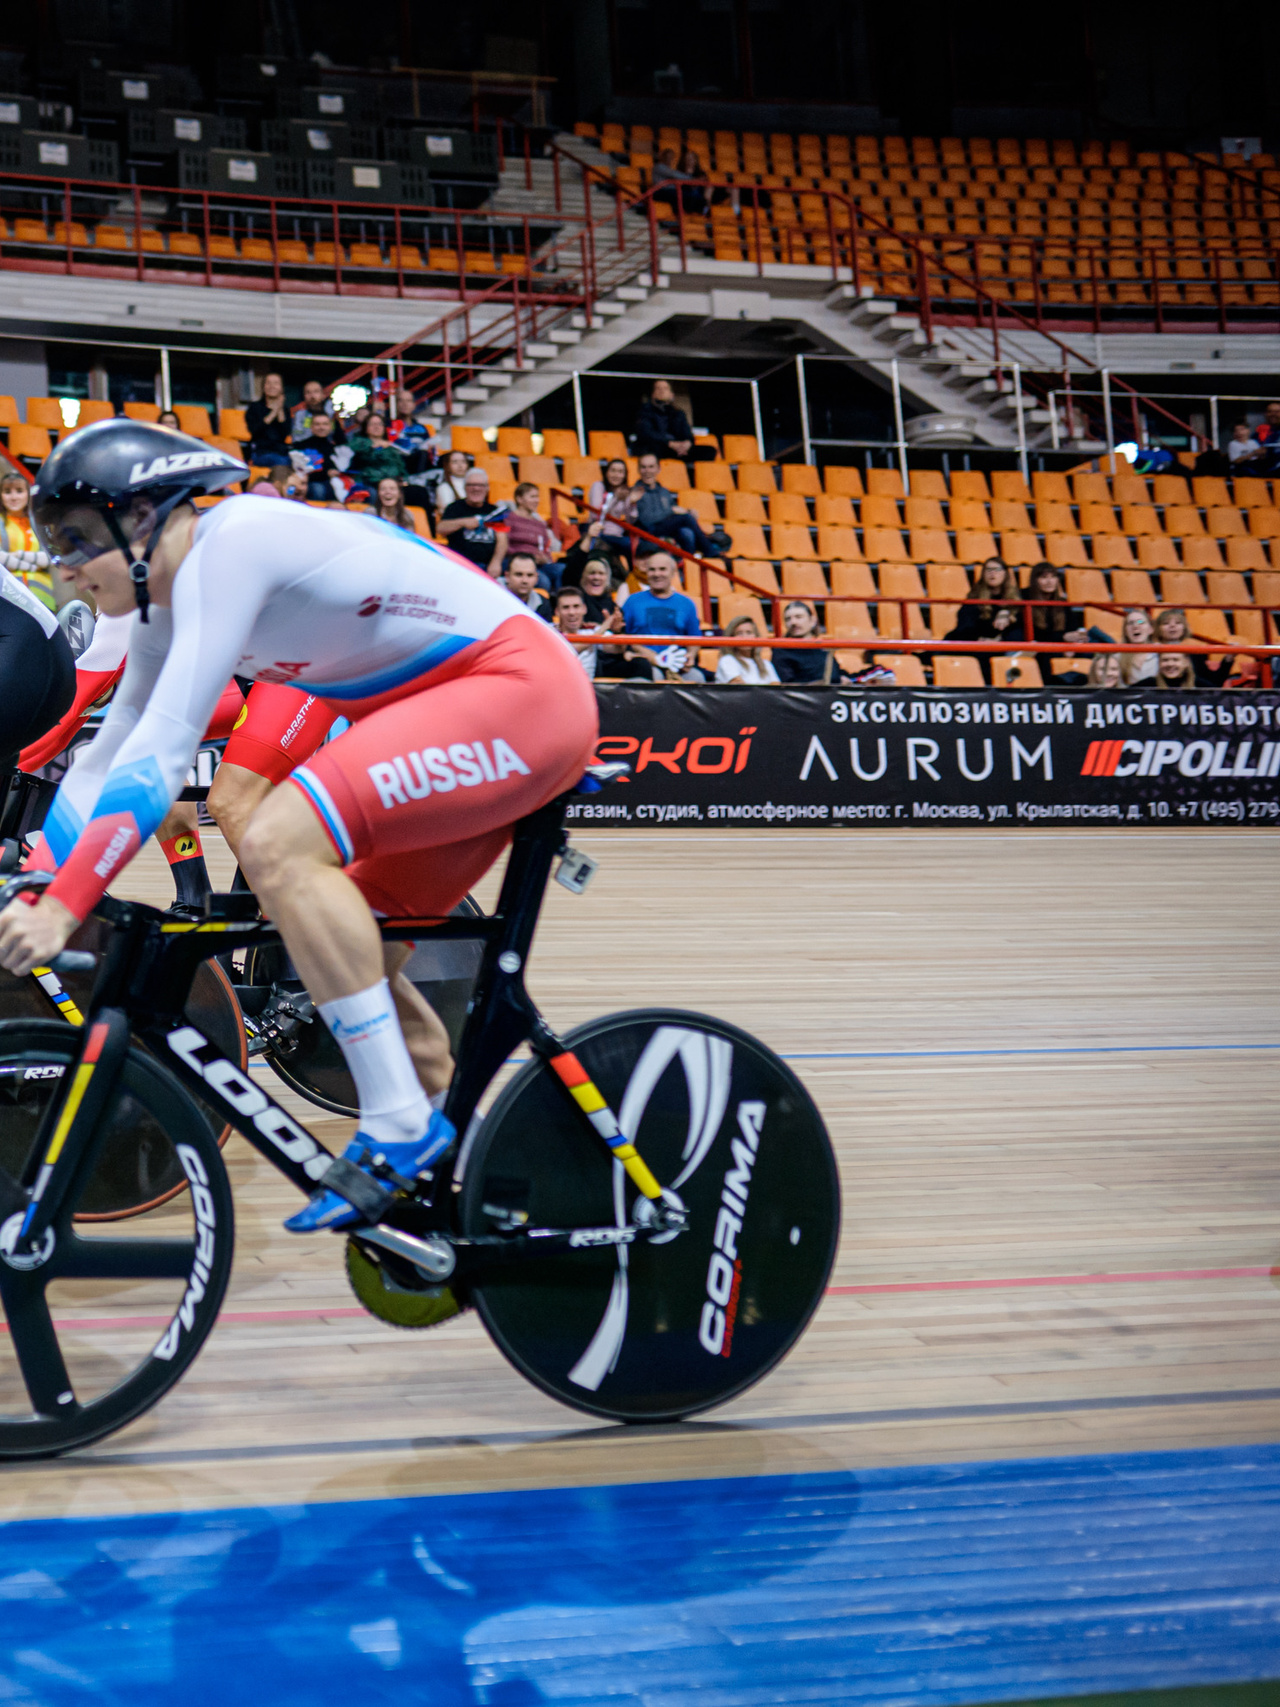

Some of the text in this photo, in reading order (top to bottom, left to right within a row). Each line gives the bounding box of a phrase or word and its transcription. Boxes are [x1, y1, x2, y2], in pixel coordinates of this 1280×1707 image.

[129, 451, 224, 485] LAZER
[383, 605, 457, 627] HELICOPTERS
[389, 594, 439, 608] RUSSIAN
[830, 699, 1074, 724] ЭКСКЛЮЗИВНЫЙ
[367, 738, 532, 810] RUSSIA
[799, 735, 1053, 781] AURUM
[566, 804, 632, 821] агазин,
[636, 804, 704, 822] студия,
[707, 801, 829, 822] атмосферное
[832, 804, 891, 819] место:
[894, 805, 908, 819] г.
[912, 802, 984, 820] Москва,
[987, 804, 1012, 822] ул.
[1016, 802, 1123, 821] Крылатская,
[1126, 804, 1143, 820] д.
[1148, 802, 1173, 818] 10.
[1177, 801, 1197, 817] +7
[1201, 801, 1245, 821] (495)
[93, 825, 135, 879] RUSSIA
[698, 1100, 767, 1356] CORIMA
[153, 1143, 217, 1360] CORIMA
